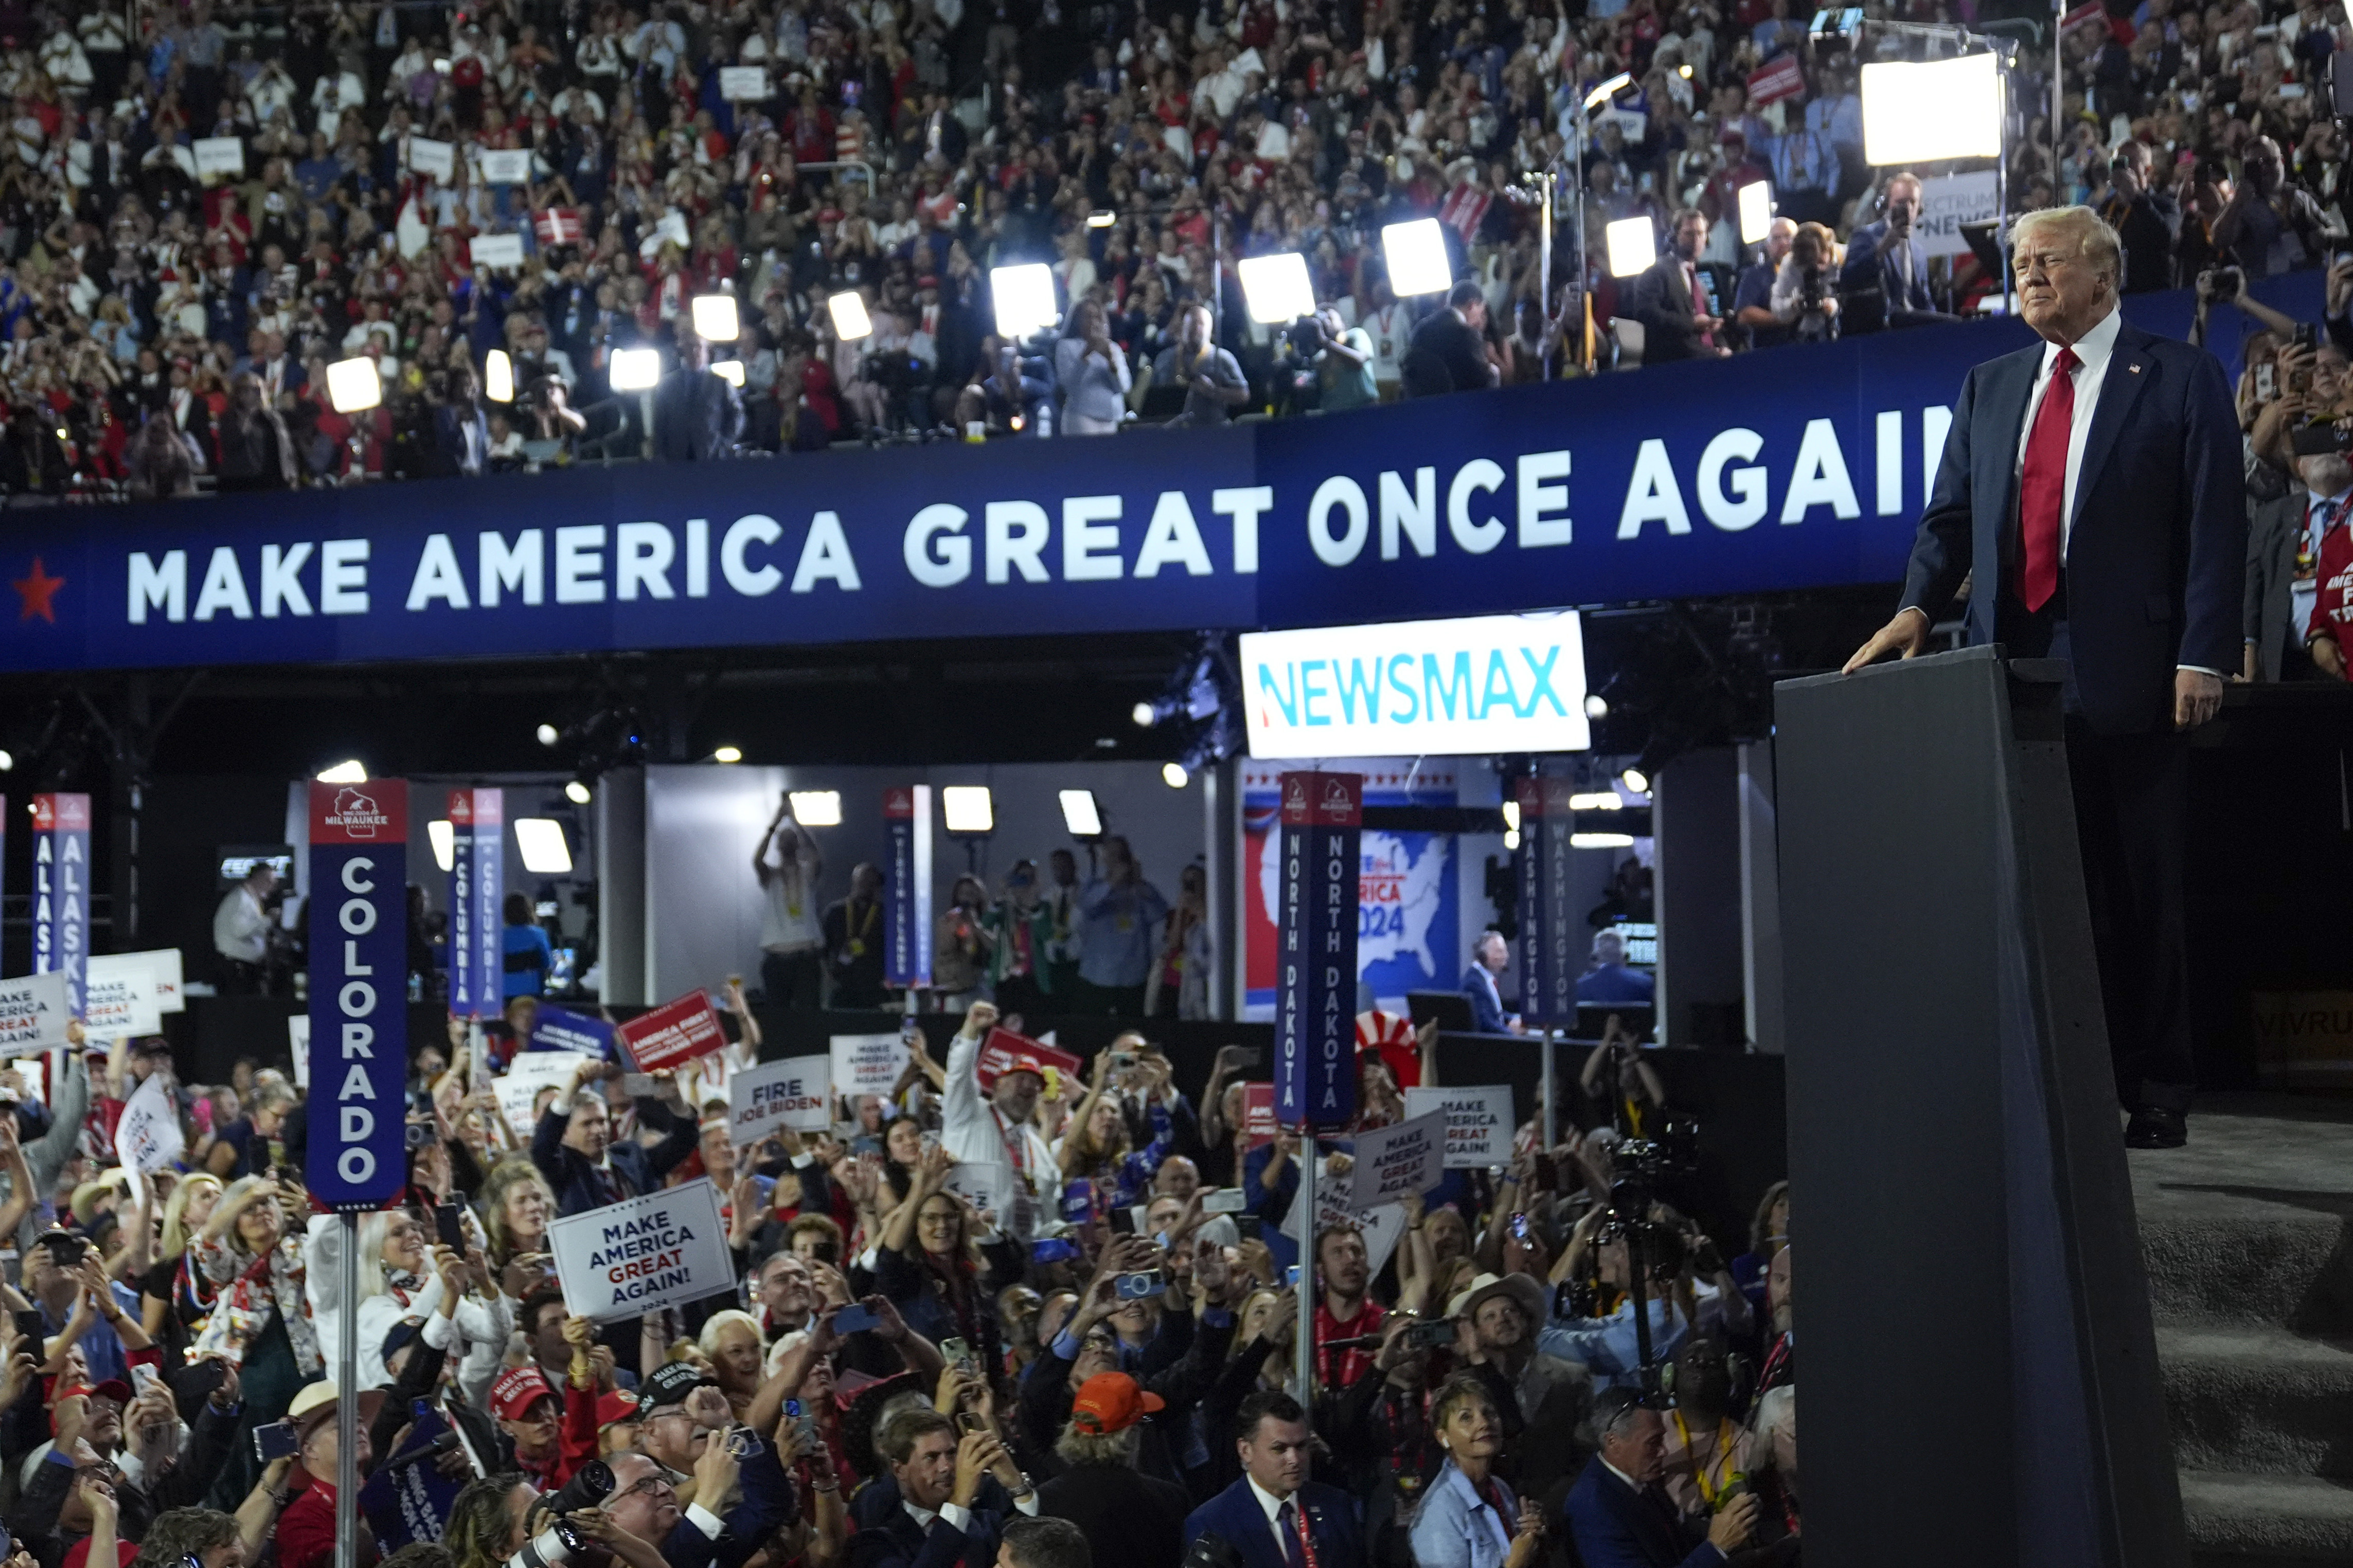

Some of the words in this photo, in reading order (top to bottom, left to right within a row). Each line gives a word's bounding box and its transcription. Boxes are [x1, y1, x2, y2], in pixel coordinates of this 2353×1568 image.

[1923, 191, 1997, 213] ECTRUM
[128, 539, 369, 623] MAKE
[406, 514, 861, 610] AMERICA
[903, 485, 1273, 587] GREAT
[1308, 450, 1572, 566] ONCE
[1258, 645, 1568, 728] NEWSMAX
[325, 816, 388, 825] MILWAUKEE
[37, 835, 52, 975] ALASK
[1288, 834, 1300, 951] NORTH
[1327, 835, 1343, 952] NORTH
[1360, 883, 1401, 903] RICA
[455, 862, 470, 1003] COLUMBIA
[482, 861, 495, 1003] COLUMBIA
[1359, 906, 1404, 938] 024
[1524, 823, 1538, 1014] WASHINGTON
[1553, 824, 1567, 1014] WASHINGTON
[0, 989, 32, 1003] AKE
[0, 1002, 48, 1017] ERICA
[0, 1015, 37, 1030] REAT
[337, 857, 377, 1184] COLORADO
[632, 1024, 681, 1051] AMERICA
[679, 1009, 709, 1030] FIRST
[1284, 965, 1297, 1107] DAKOTA
[1323, 966, 1340, 1108] DAKOTA
[848, 1054, 900, 1065] AMERICA
[752, 1078, 803, 1105] FIRE
[1441, 1100, 1486, 1112] MAKE
[736, 1105, 765, 1126] JOE
[769, 1096, 823, 1115] BIDEN
[1385, 1127, 1423, 1150] MAKE
[1445, 1142, 1491, 1154] GAIN!
[1448, 1128, 1489, 1140] REAT
[1372, 1139, 1432, 1169] AMERICA
[1381, 1156, 1424, 1180] GREAT
[602, 1211, 671, 1245] MAKE
[589, 1225, 696, 1270] AMERICA
[608, 1248, 683, 1284] GREAT
[611, 1267, 691, 1305] AGAIN!
[640, 1298, 668, 1312] 2024
[494, 1376, 515, 1397] MAKE
[652, 1365, 677, 1383] MAKE
[503, 1381, 524, 1402] GREAT
